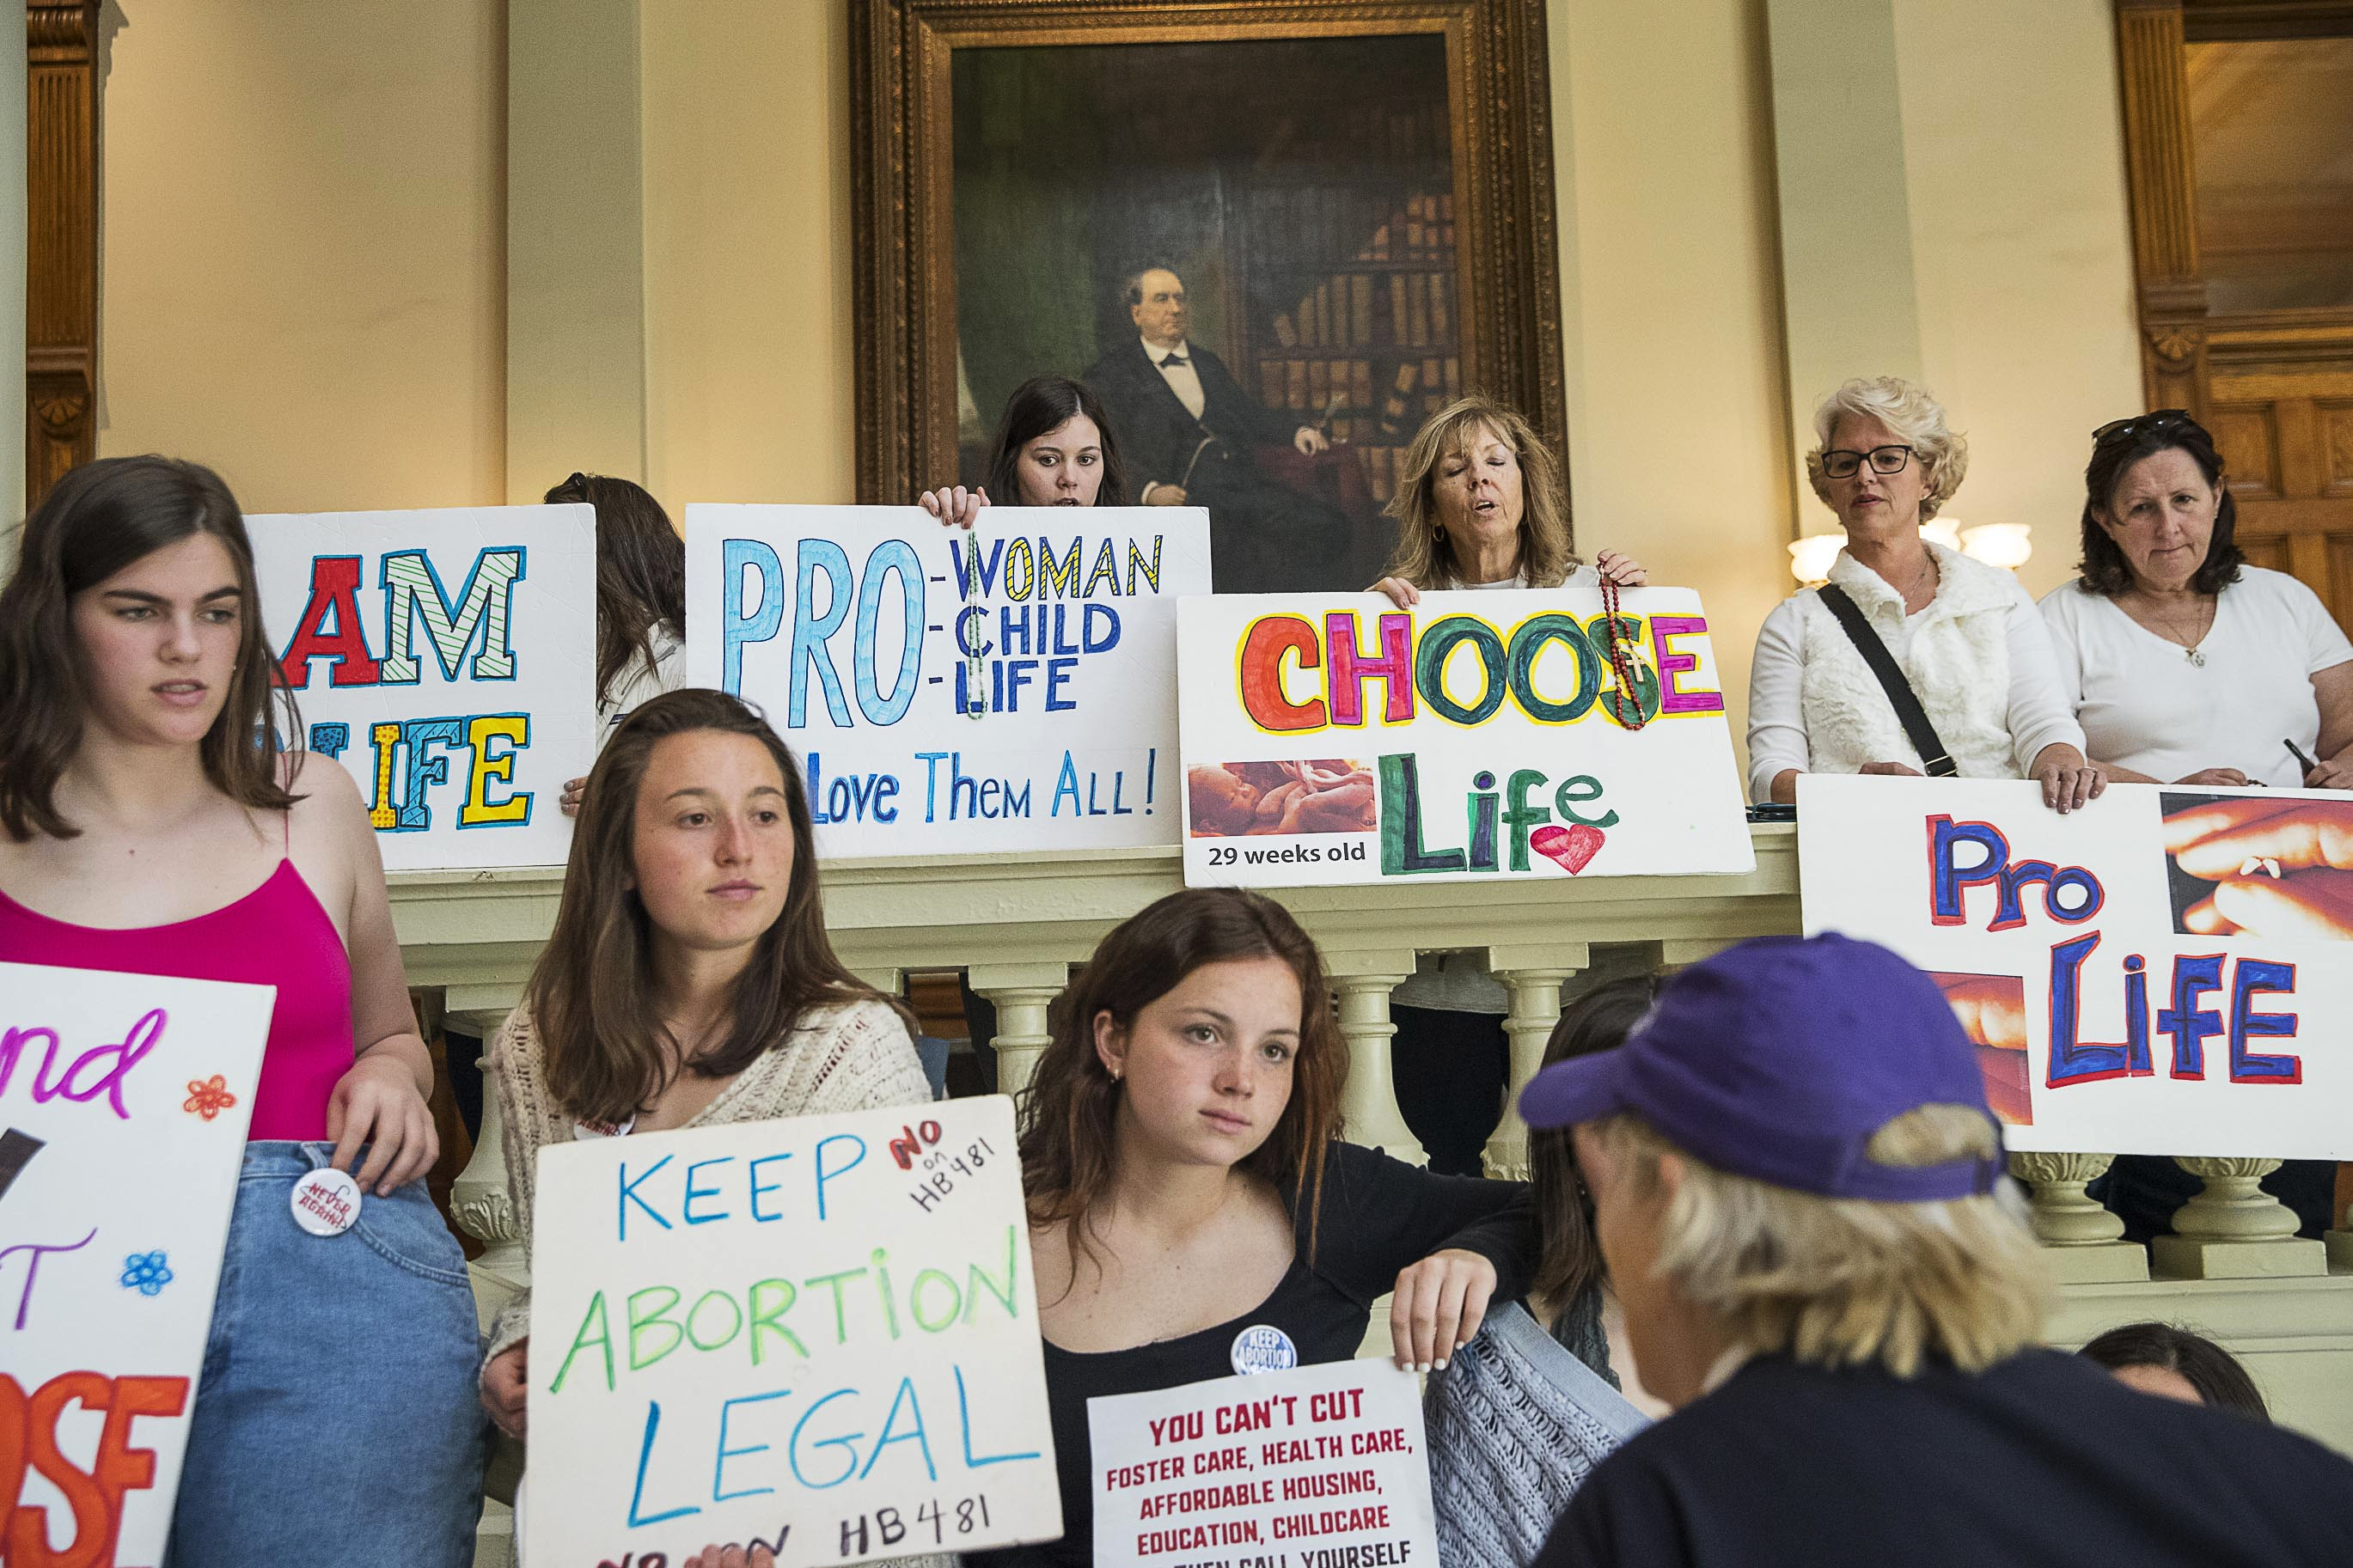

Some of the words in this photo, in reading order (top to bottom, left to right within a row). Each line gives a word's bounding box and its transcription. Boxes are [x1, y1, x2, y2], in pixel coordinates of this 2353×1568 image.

[268, 546, 527, 690] AM
[1238, 611, 1724, 733] CHOOSE
[806, 751, 900, 825] Love
[1378, 753, 1619, 876] Life
[1208, 847, 1238, 866] 29
[1244, 844, 1321, 864] weeks
[1327, 841, 1366, 862] old
[1925, 814, 2105, 931] Pro
[889, 1120, 942, 1169] NO
[909, 1172, 953, 1212] HB
[949, 1137, 994, 1176] 481
[309, 1182, 351, 1214] NEVER
[620, 1134, 866, 1242] KEEP
[1238, 1345, 1293, 1368] ABORTION
[1249, 1330, 1281, 1349] KEEP
[628, 1364, 1042, 1528] LEGAL
[1149, 1411, 1204, 1446] YOU
[1215, 1395, 1298, 1435] CAN'T
[1311, 1388, 1365, 1423] CUT
[1107, 1455, 1185, 1491] FOSTER
[1194, 1447, 1254, 1473] CARE,
[1262, 1436, 1342, 1466] HEALTH
[1352, 1428, 1413, 1455] CARE,
[840, 1507, 907, 1557] HB
[917, 1494, 990, 1545] 481
[1140, 1480, 1274, 1520] AFFORDABLE
[1283, 1469, 1383, 1500] HOUSING,
[1137, 1520, 1265, 1556] EDUCATION,
[1273, 1505, 1390, 1540] CHILDCARE
[1300, 1541, 1411, 1568] YOURSELF
